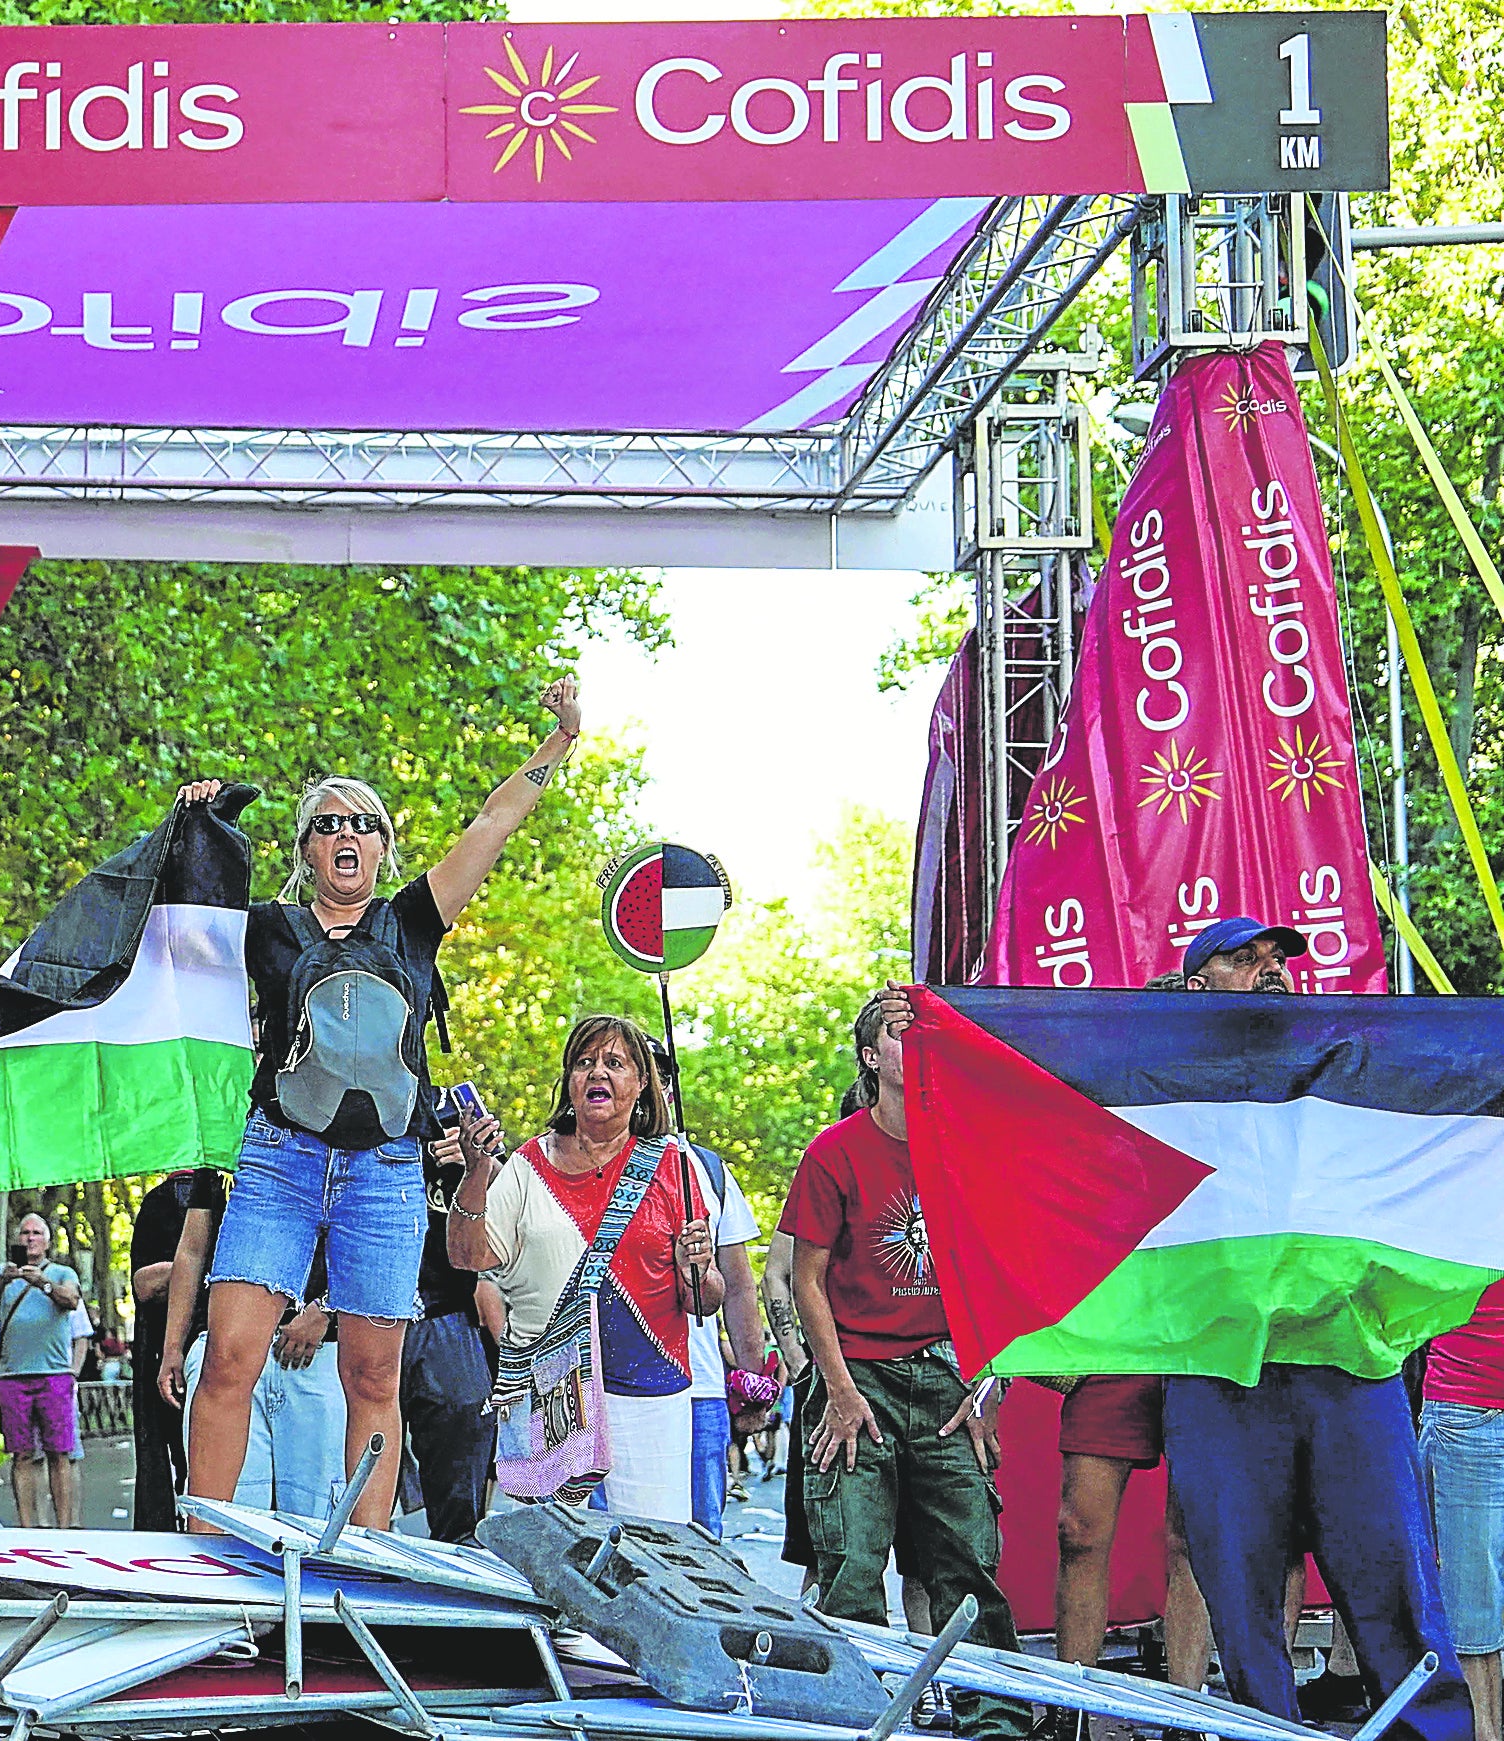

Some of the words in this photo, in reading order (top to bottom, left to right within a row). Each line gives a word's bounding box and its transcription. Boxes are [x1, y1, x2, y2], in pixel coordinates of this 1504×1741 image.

[634, 52, 1071, 145] Cofidis
[1279, 33, 1321, 125] 1
[1280, 136, 1320, 169] KM
[1119, 508, 1191, 732] Cofidis
[1242, 480, 1316, 718] Cofidis
[342, 982, 351, 1021] Quechua
